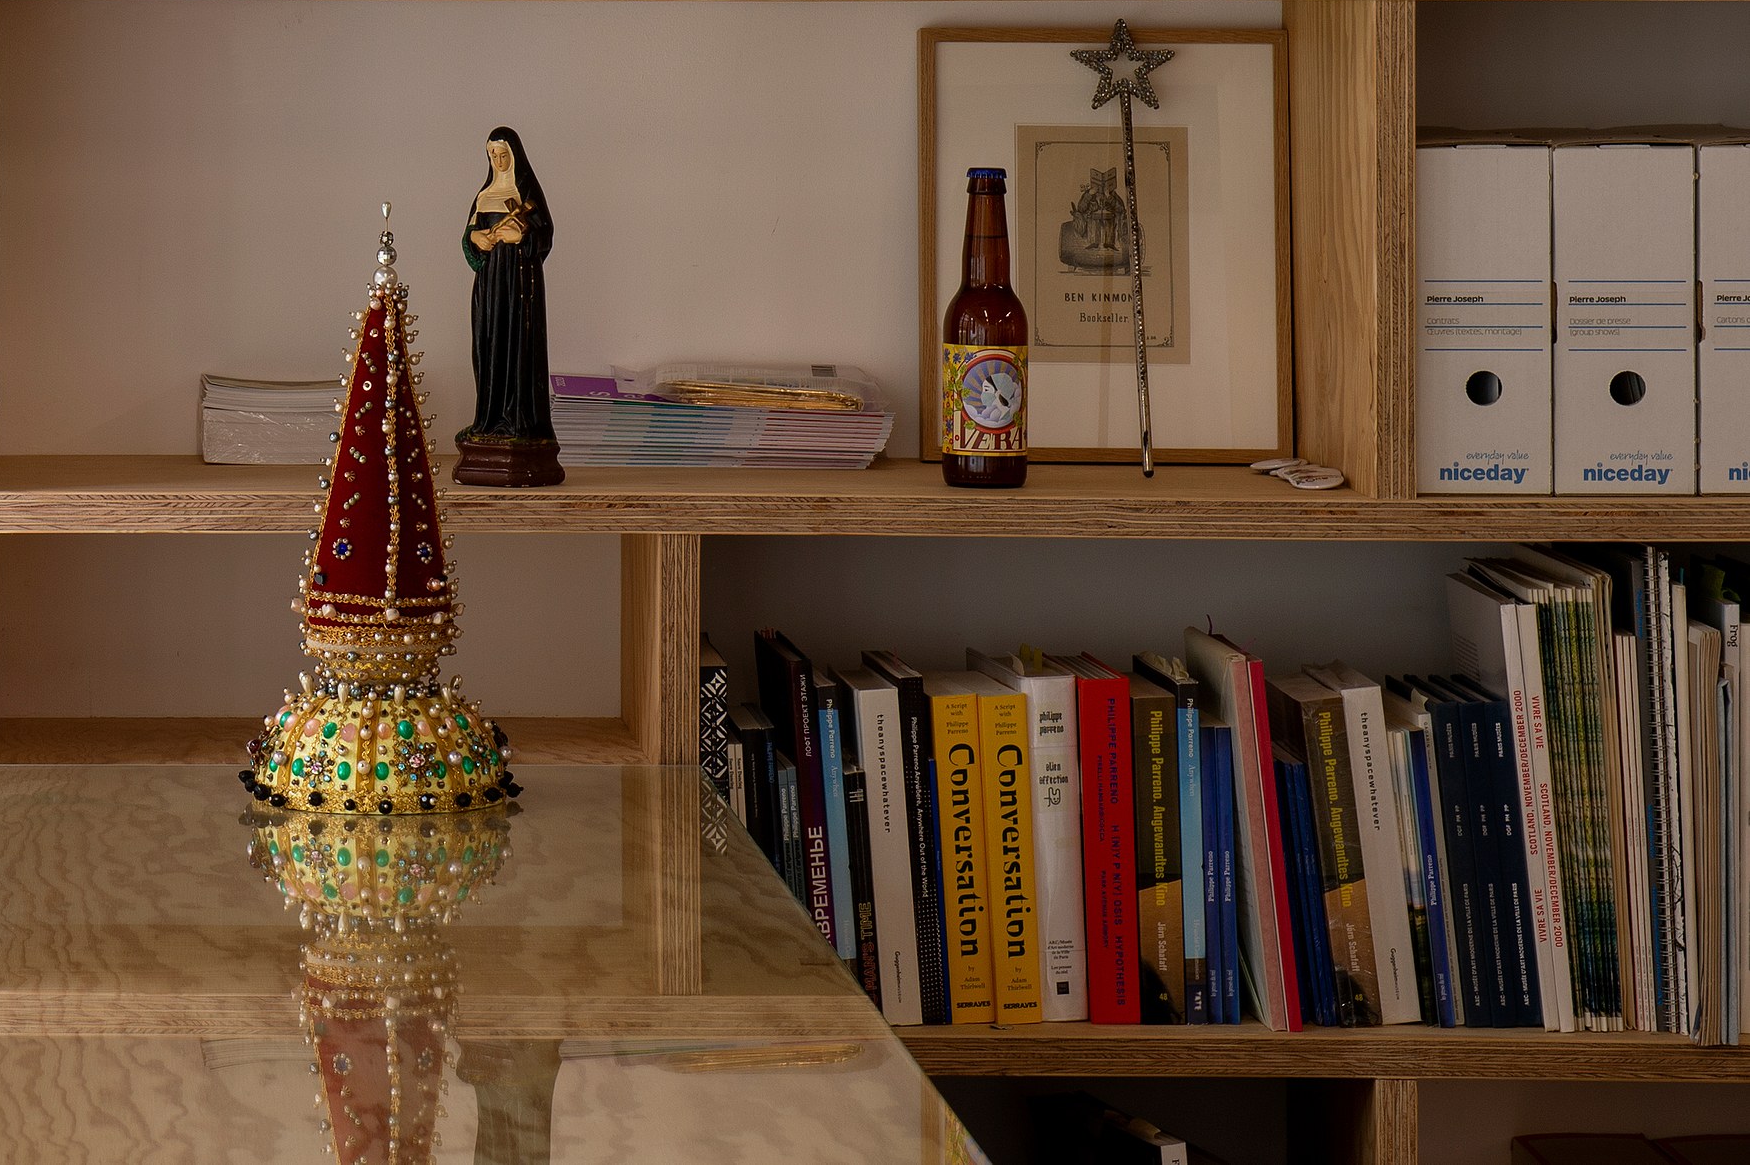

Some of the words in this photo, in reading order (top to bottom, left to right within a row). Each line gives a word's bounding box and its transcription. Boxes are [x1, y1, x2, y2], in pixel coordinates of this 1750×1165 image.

[1064, 293, 1084, 302] BEN
[1092, 293, 1133, 302] KINMON
[1426, 295, 1452, 303] Pierre
[1453, 295, 1484, 303] Joseph
[960, 421, 1022, 450] VERA
[1440, 462, 1526, 484] niceday
[1584, 462, 1670, 484] niceday
[1726, 624, 1738, 647] Frog
[825, 698, 834, 727] Philippe
[1513, 690, 1523, 712] 2000
[802, 703, 810, 735] ПРОЕКТ
[1106, 698, 1117, 749] PHILIPPE
[1149, 710, 1163, 754] Philippe
[828, 728, 836, 759] Parreno
[876, 713, 891, 834] theanyspacewhatever
[1516, 714, 1533, 807] NOVEMBER/DECEMBER
[1108, 752, 1119, 805] PARRENO
[1152, 757, 1164, 803] Parreno.
[916, 808, 924, 841] Anywhere
[1527, 809, 1538, 855] SCOTLAND,
[948, 743, 984, 957] Conversation
[996, 744, 1032, 959] Conversation
[1151, 805, 1167, 879] Angewandtes
[1156, 882, 1168, 906] Kino
[1534, 889, 1543, 903] VIE
[1536, 905, 1545, 917] SA
[1538, 918, 1547, 943] VIVRE
[1114, 935, 1125, 1006] HYPOTHESIS
[1158, 941, 1168, 971] Schafaff
